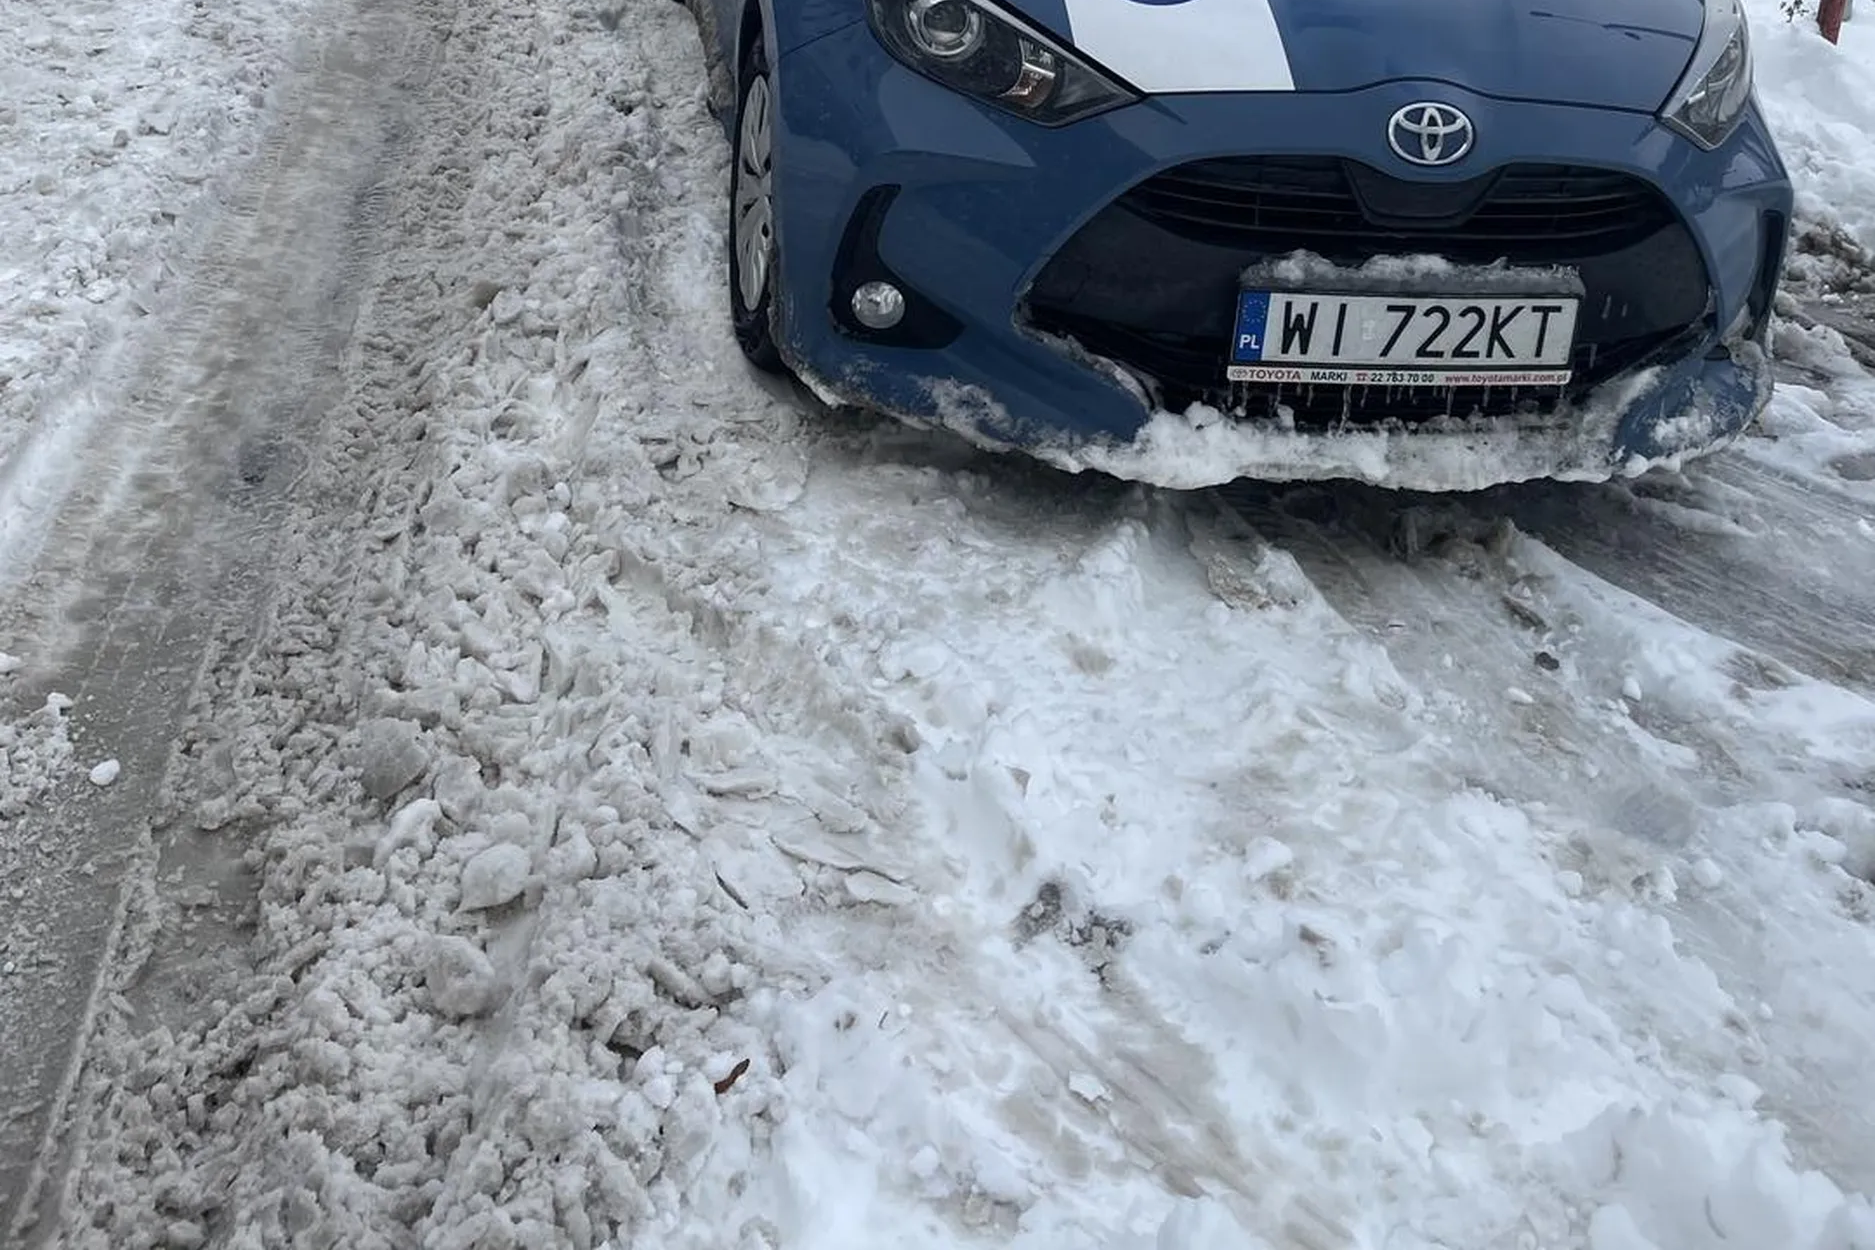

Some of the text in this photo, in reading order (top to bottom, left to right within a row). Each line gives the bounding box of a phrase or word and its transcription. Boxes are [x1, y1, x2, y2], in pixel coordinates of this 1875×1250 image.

[1280, 300, 1562, 359] WI 722KT
[1239, 334, 1260, 349] PL
[1249, 369, 1301, 381] TOYOTA
[1310, 371, 1348, 382] MARKI
[1371, 373, 1383, 382] 22
[1407, 373, 1419, 383] 70
